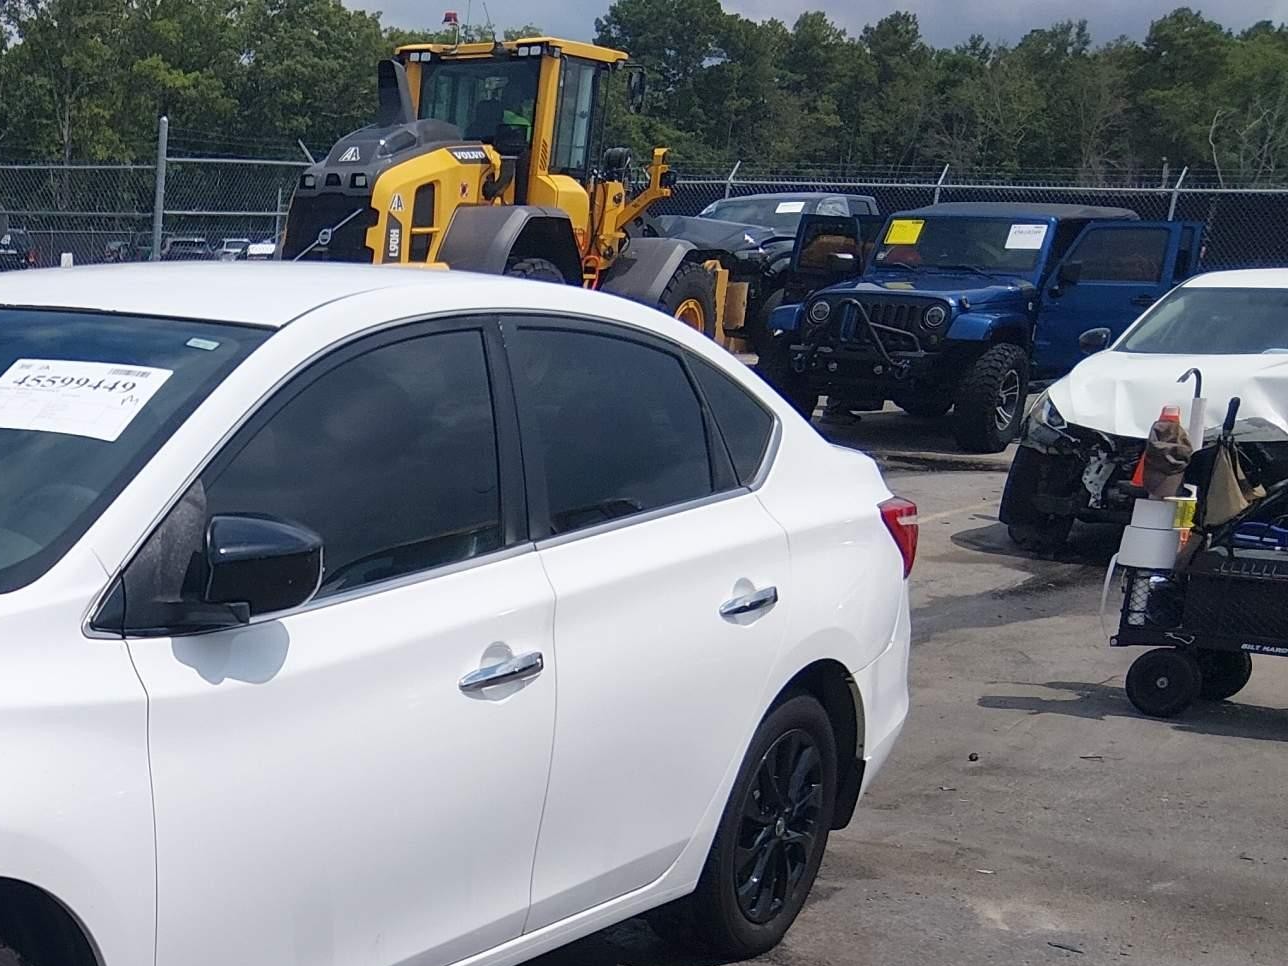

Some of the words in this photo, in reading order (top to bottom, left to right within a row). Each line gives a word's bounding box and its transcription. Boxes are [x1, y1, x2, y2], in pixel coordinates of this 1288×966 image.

[453, 151, 485, 160] VOLVO
[389, 229, 400, 257] L90H
[13, 375, 136, 393] 45599449
